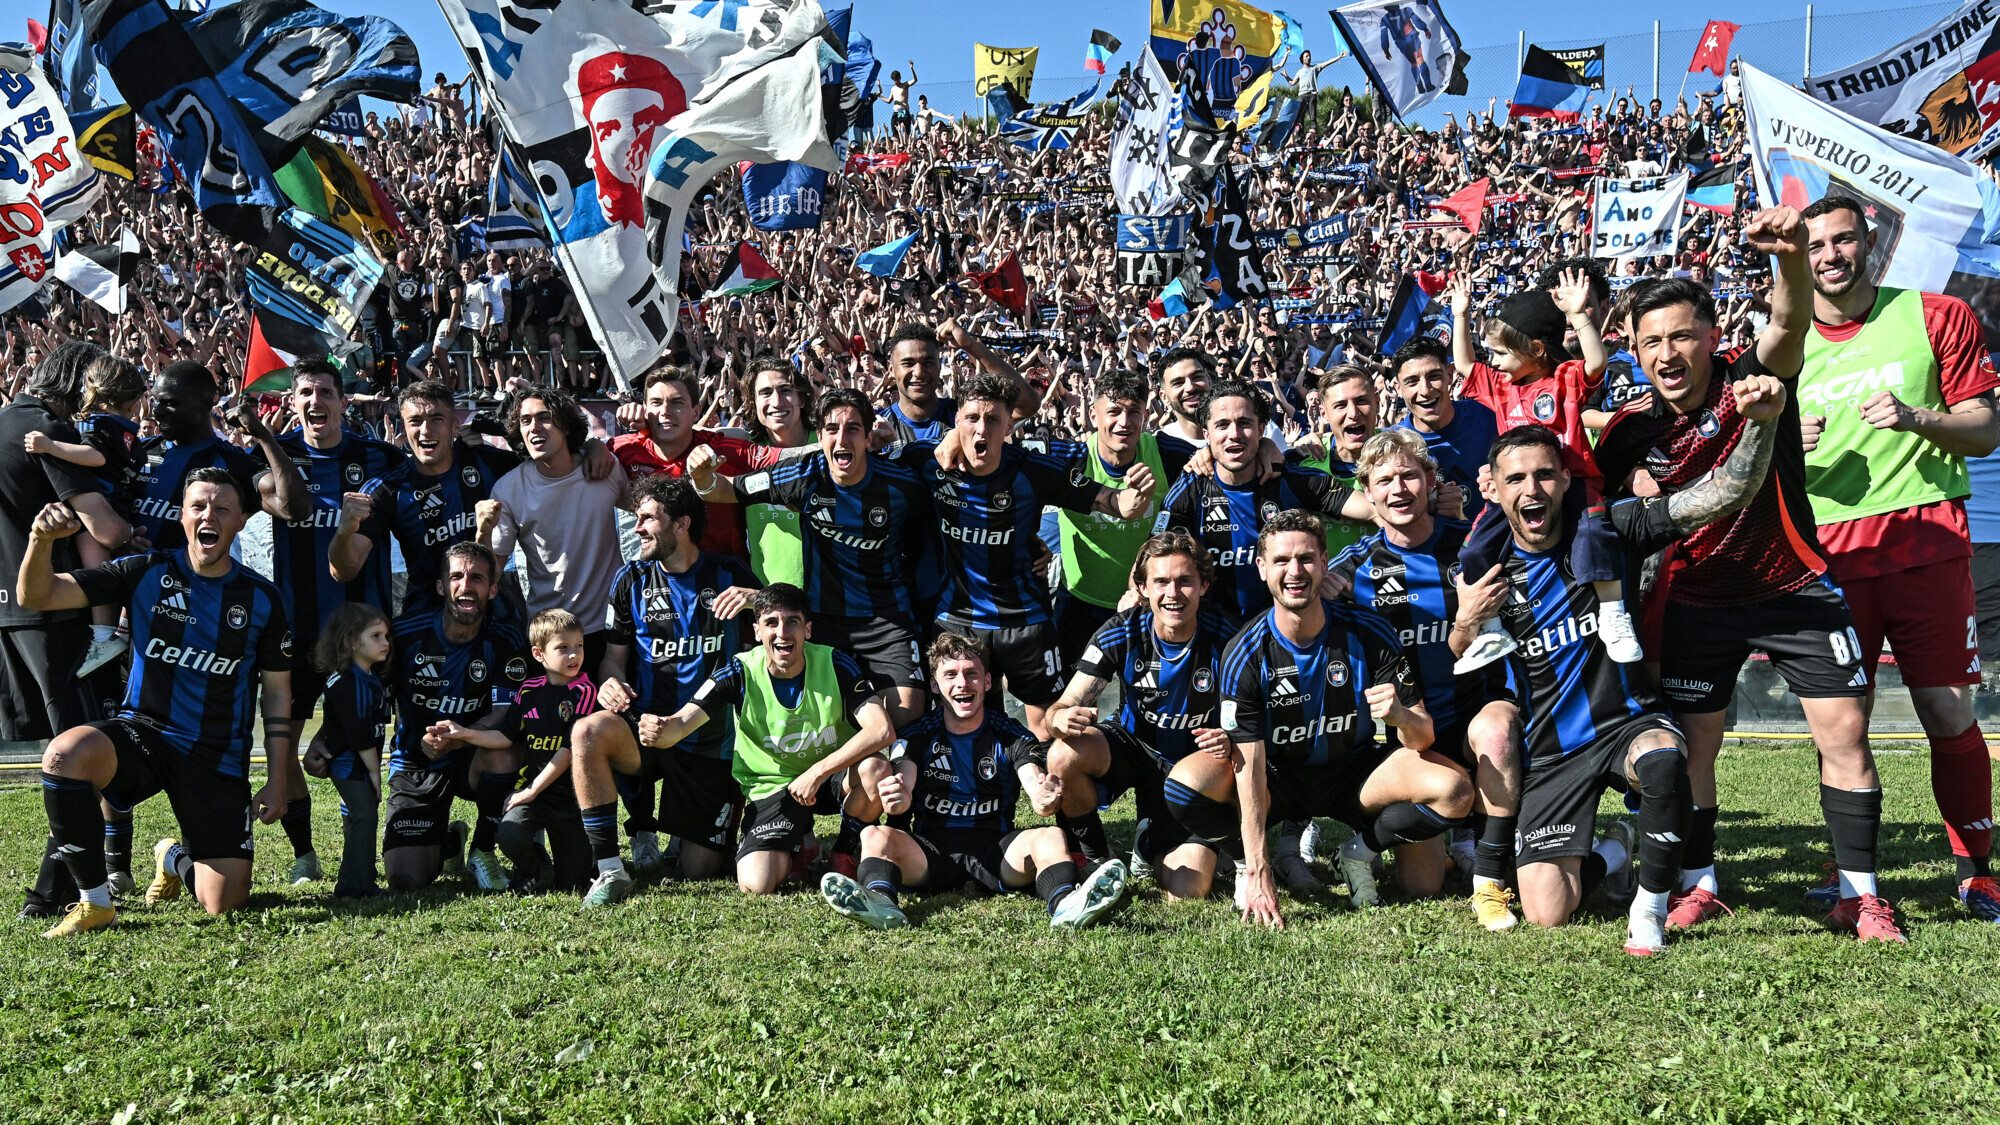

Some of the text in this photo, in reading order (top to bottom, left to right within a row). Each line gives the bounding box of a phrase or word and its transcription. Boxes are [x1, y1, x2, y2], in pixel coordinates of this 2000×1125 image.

[1816, 0, 1997, 101] TRADIZIONE
[320, 111, 360, 130] STO
[1602, 178, 1666, 194] IO CHE
[1869, 164, 1929, 204] 2011
[1304, 220, 1344, 241] Clan
[1596, 229, 1674, 248] SOLO TE
[1803, 386, 1905, 417] SPOT
[132, 496, 182, 521] etila
[941, 518, 1015, 546] Cetilar
[144, 637, 242, 676] Cetilar
[651, 633, 725, 658] Cetilar
[1828, 625, 1862, 666] 80
[1661, 678, 1714, 692] TONI LUIGI
[1272, 711, 1358, 745] Cetlar
[392, 819, 434, 829] TONI LUIGI
[750, 823, 771, 836] TONI
[772, 820, 795, 831] LUIGI
[1547, 823, 1576, 833] LUIGI
